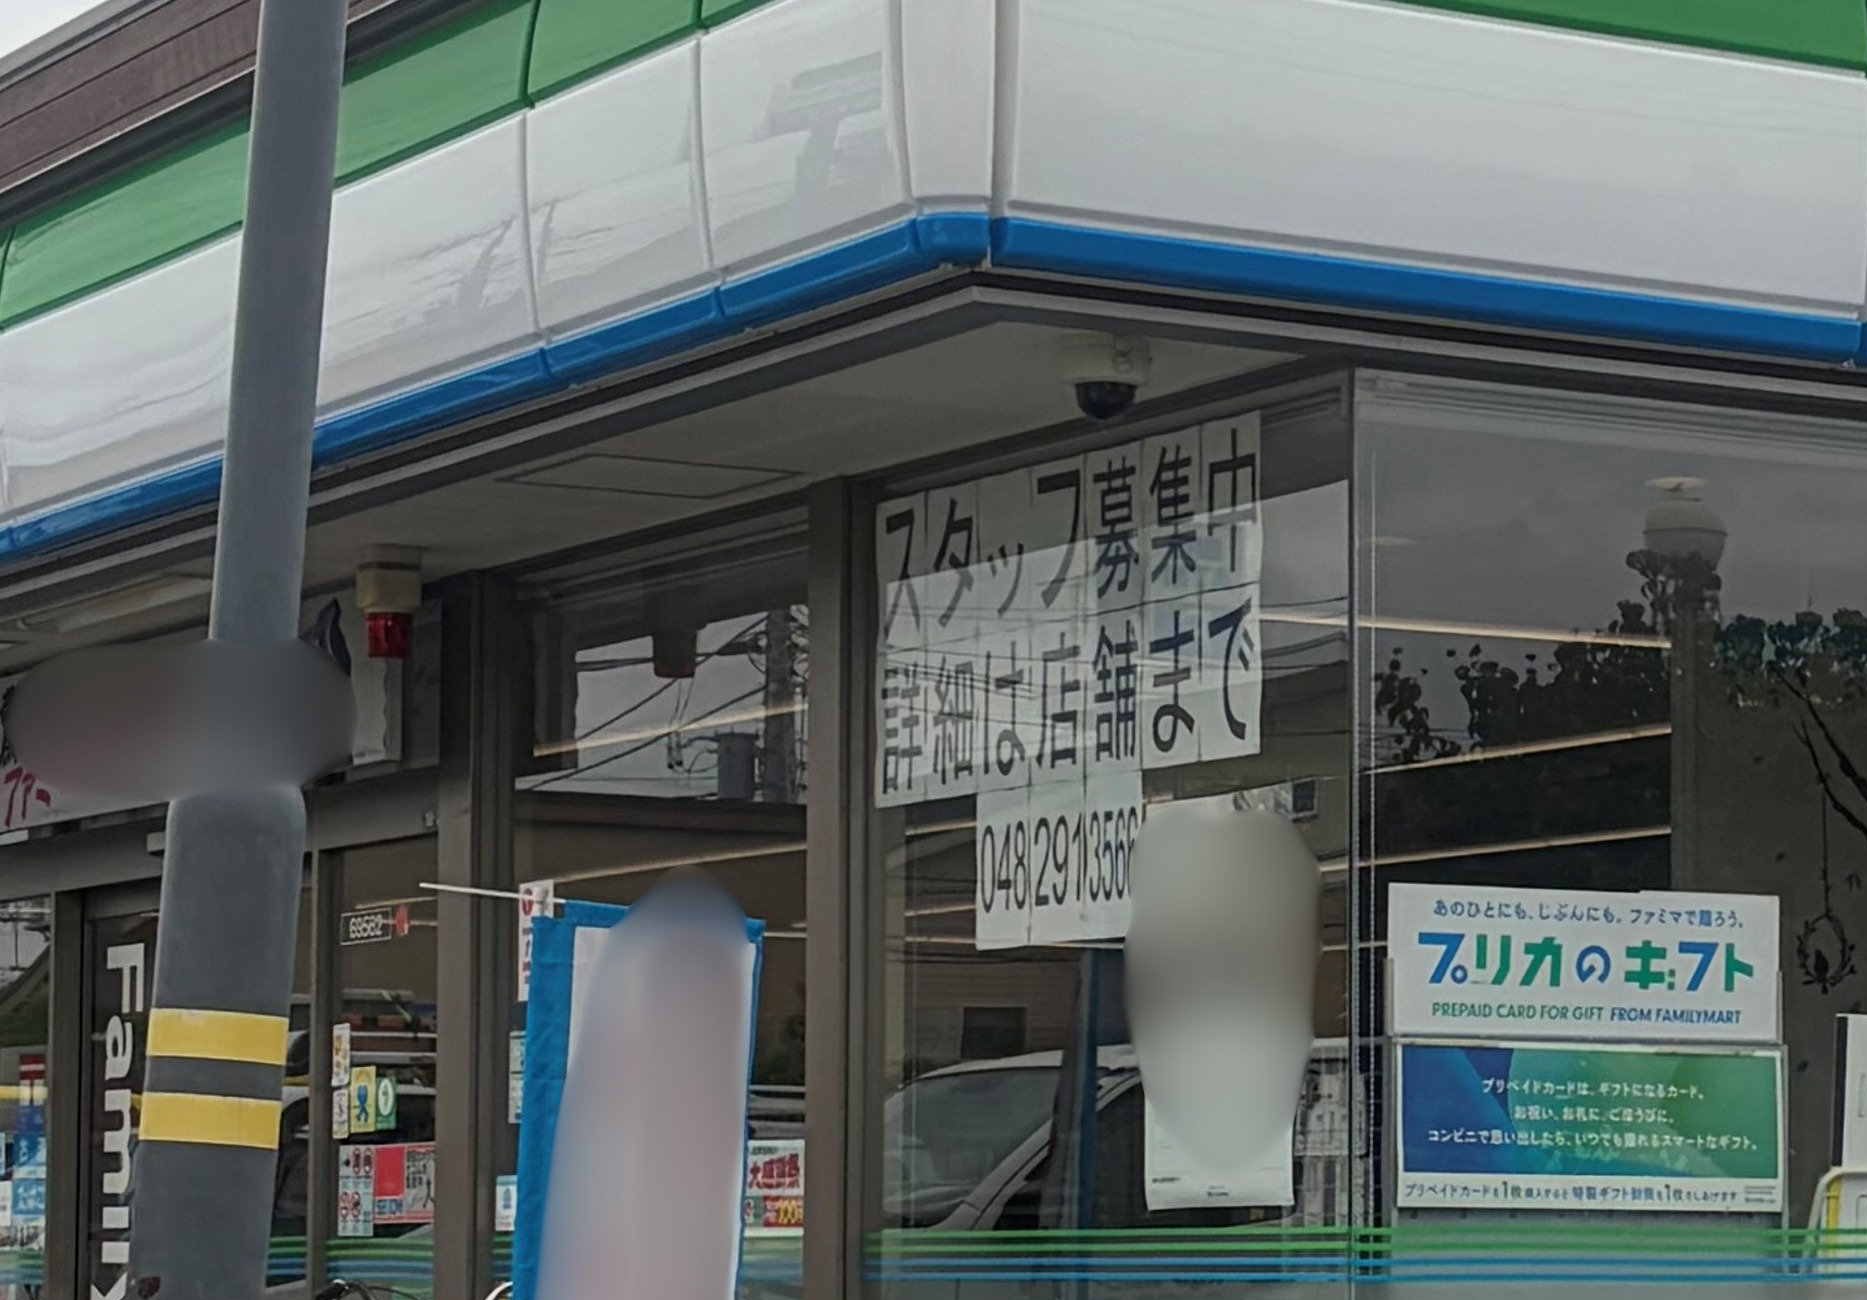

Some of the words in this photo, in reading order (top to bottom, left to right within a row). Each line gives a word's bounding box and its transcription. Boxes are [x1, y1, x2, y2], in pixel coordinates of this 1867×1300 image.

[884, 428, 1256, 640] スタッフ募集中
[882, 597, 1255, 795] 詳細は店舗まで
[1417, 931, 1755, 993] プリカのギフト
[1431, 1002, 1493, 1018] PREPAID
[1496, 1003, 1536, 1020] CARD
[1540, 1005, 1569, 1021] FOR
[1572, 1005, 1605, 1021] GIFT
[1610, 1006, 1652, 1023] FROM
[1655, 1007, 1742, 1024] FAMILYMART
